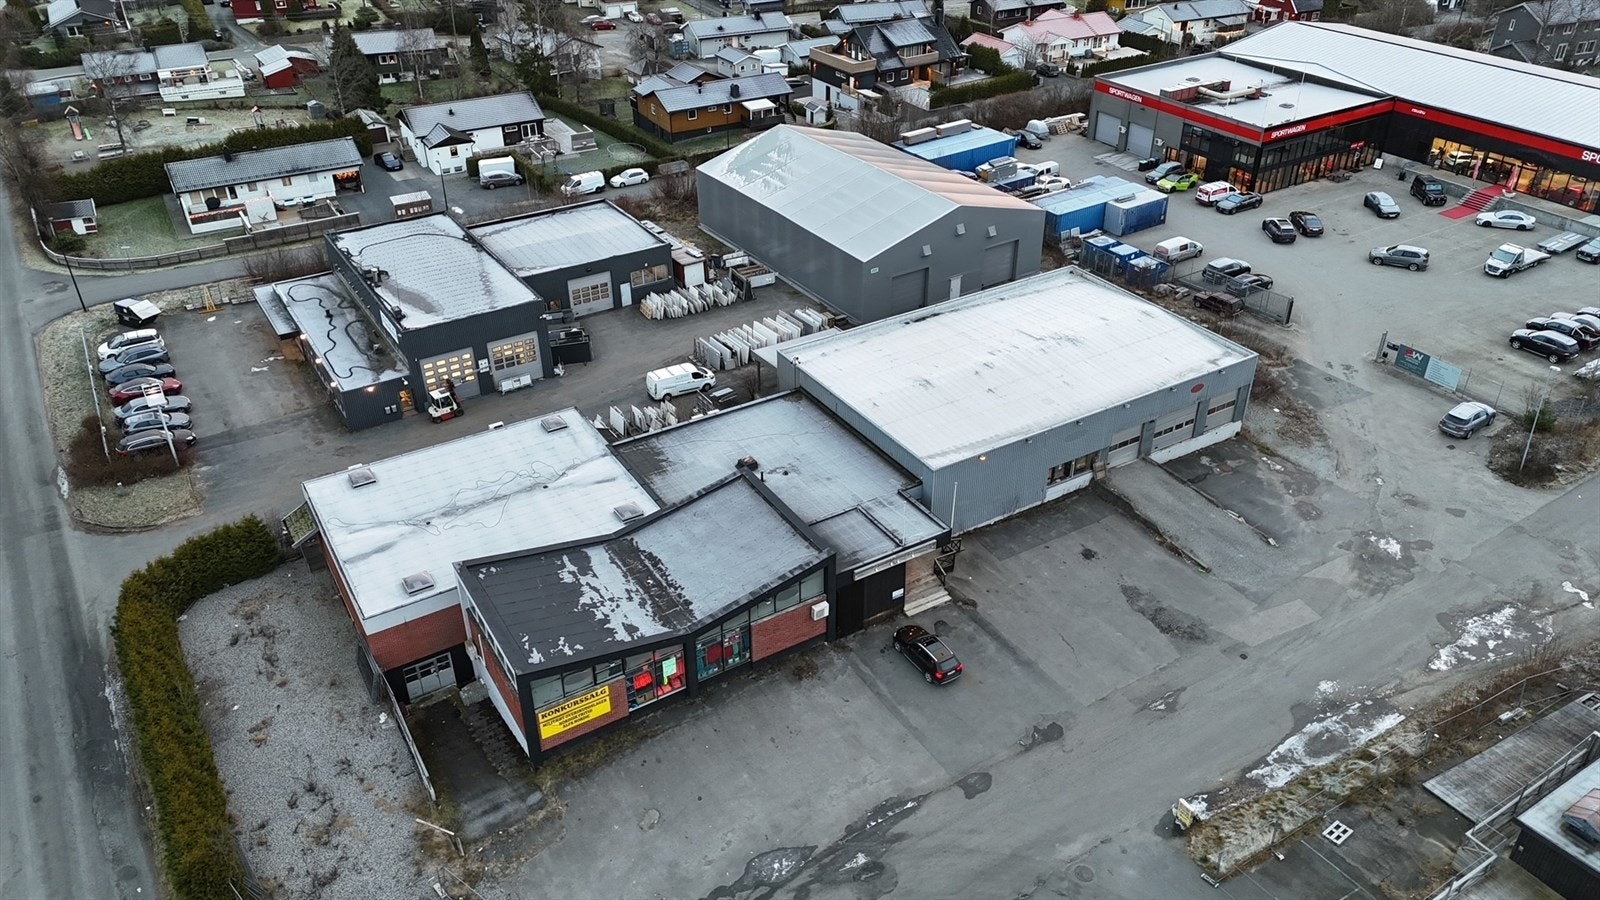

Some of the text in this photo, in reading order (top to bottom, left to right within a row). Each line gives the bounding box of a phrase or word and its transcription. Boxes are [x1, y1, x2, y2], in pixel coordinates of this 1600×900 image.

[1109, 87, 1142, 102] SPORTWAGEN
[1271, 124, 1306, 138] SPORTWAGEN
[541, 688, 607, 719] KONKURSSALG
